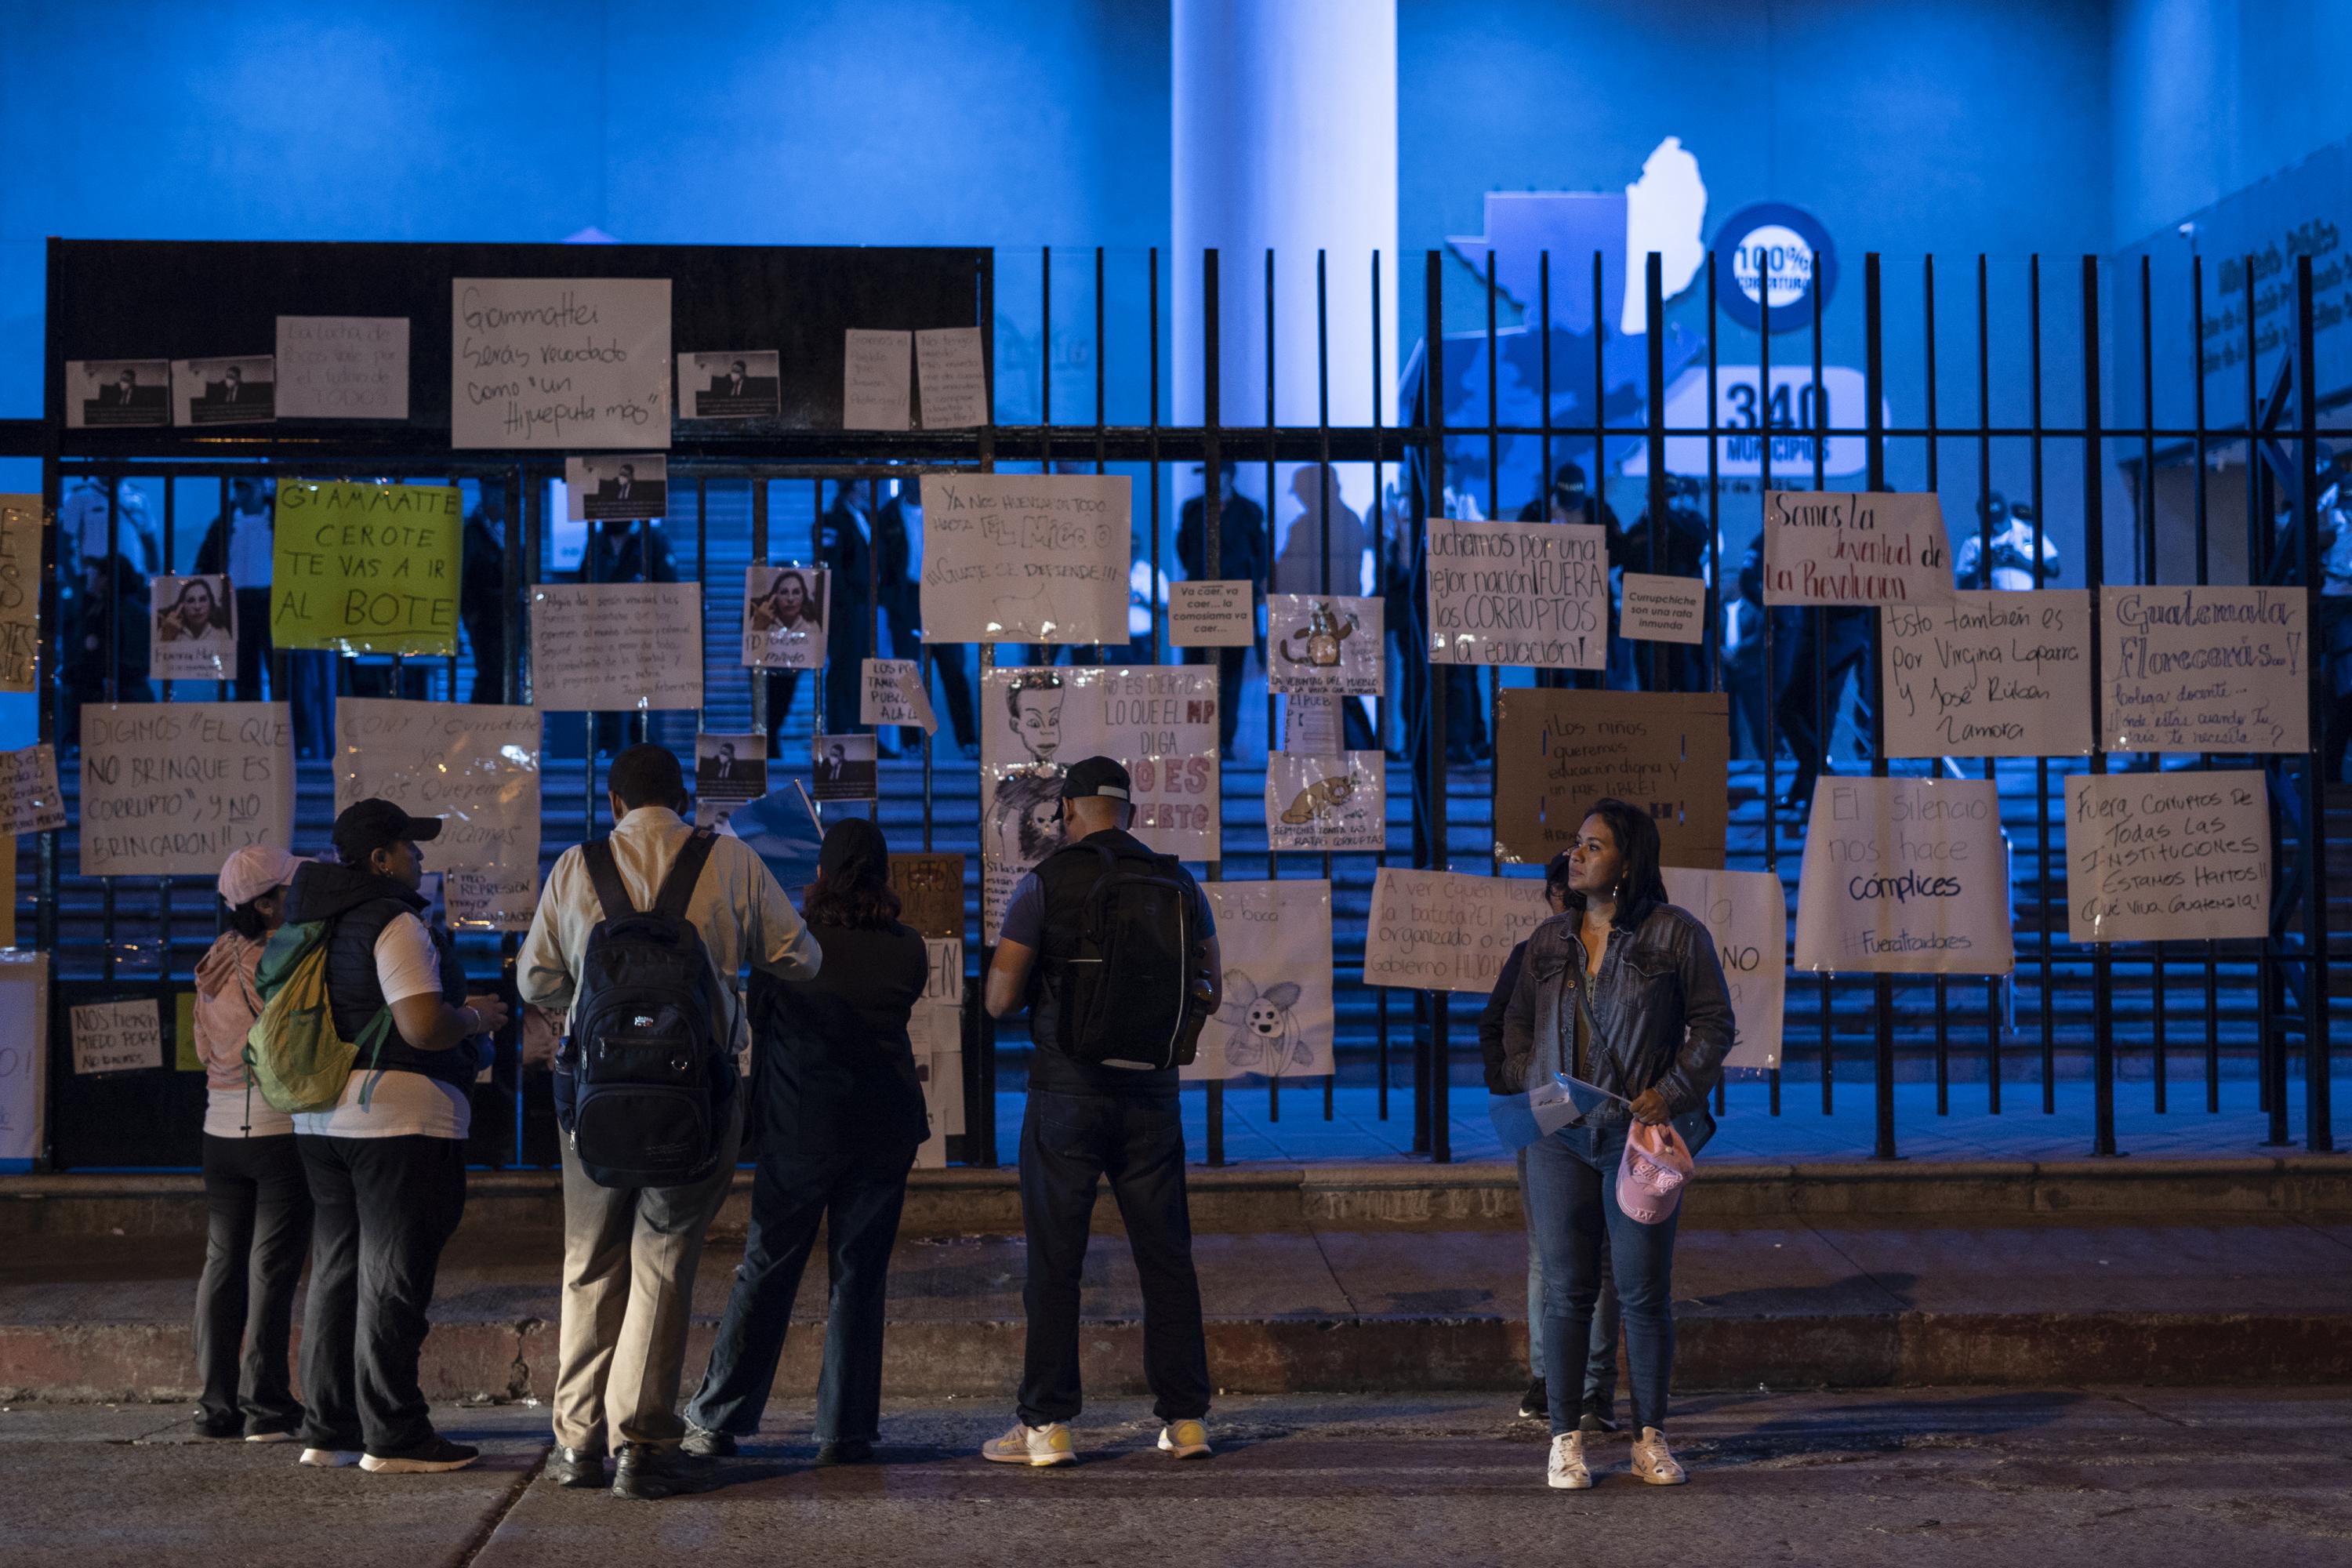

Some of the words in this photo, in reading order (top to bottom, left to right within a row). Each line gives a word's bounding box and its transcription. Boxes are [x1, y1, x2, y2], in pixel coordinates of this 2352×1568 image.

[941, 485, 966, 512] YA
[1072, 496, 1108, 513] TODO
[1775, 492, 1843, 528] Somos
[315, 524, 437, 548] CEROTE
[1427, 521, 1515, 560] uchamos
[1519, 535, 1551, 568] por
[1558, 536, 1597, 562] una
[1920, 533, 1944, 569] de
[283, 550, 325, 576] TE
[338, 554, 383, 578] VAS
[393, 557, 408, 578] A
[428, 559, 445, 579] IR
[1181, 586, 1195, 597] Va
[1225, 586, 1240, 597] va
[274, 590, 312, 626] AL
[345, 588, 455, 627] BOTE
[1435, 597, 1462, 629] los
[1464, 593, 1598, 633] CORRUPTOS
[1629, 604, 1650, 616] son
[1650, 607, 1671, 618] una
[1671, 608, 1695, 619] rata
[1944, 600, 2031, 633] también
[2041, 607, 2064, 632] es
[1637, 617, 1686, 631] inmunda
[1450, 630, 1473, 665] la
[1933, 636, 2002, 691] Virginia
[2011, 637, 2080, 677] Laparra
[1125, 676, 1144, 695] ES
[1929, 676, 1973, 717] José
[1104, 700, 1126, 726] LO
[1130, 700, 1159, 725] QUE
[1163, 699, 1182, 724] EL
[1185, 699, 1216, 725] MP
[1140, 730, 1178, 756] DIGA
[1597, 718, 1648, 739] niños
[1935, 714, 2026, 746] Zamora
[1552, 741, 1628, 767] queremos
[87, 754, 122, 786] NO
[131, 755, 233, 789] BRINQUE
[241, 756, 273, 783] ES
[1164, 756, 1211, 795] ES
[1831, 786, 1860, 822] El
[2077, 784, 2129, 824] Fuera
[2229, 787, 2254, 807] De
[2104, 813, 2172, 848] Todas
[2183, 816, 2227, 836] Las
[1828, 838, 1882, 862] nos
[1899, 831, 1969, 861] hace
[1382, 872, 1398, 895] A
[1406, 880, 1434, 898] ver
[1381, 902, 1396, 923] la
[1503, 909, 1548, 932] puebl
[1378, 926, 1473, 955] organizado
[1479, 933, 1494, 949] o
[1498, 929, 1517, 949] el
[1370, 953, 1448, 978] Gobierno
[75, 1007, 110, 1033] NOS
[76, 1034, 116, 1051] MIEDO
